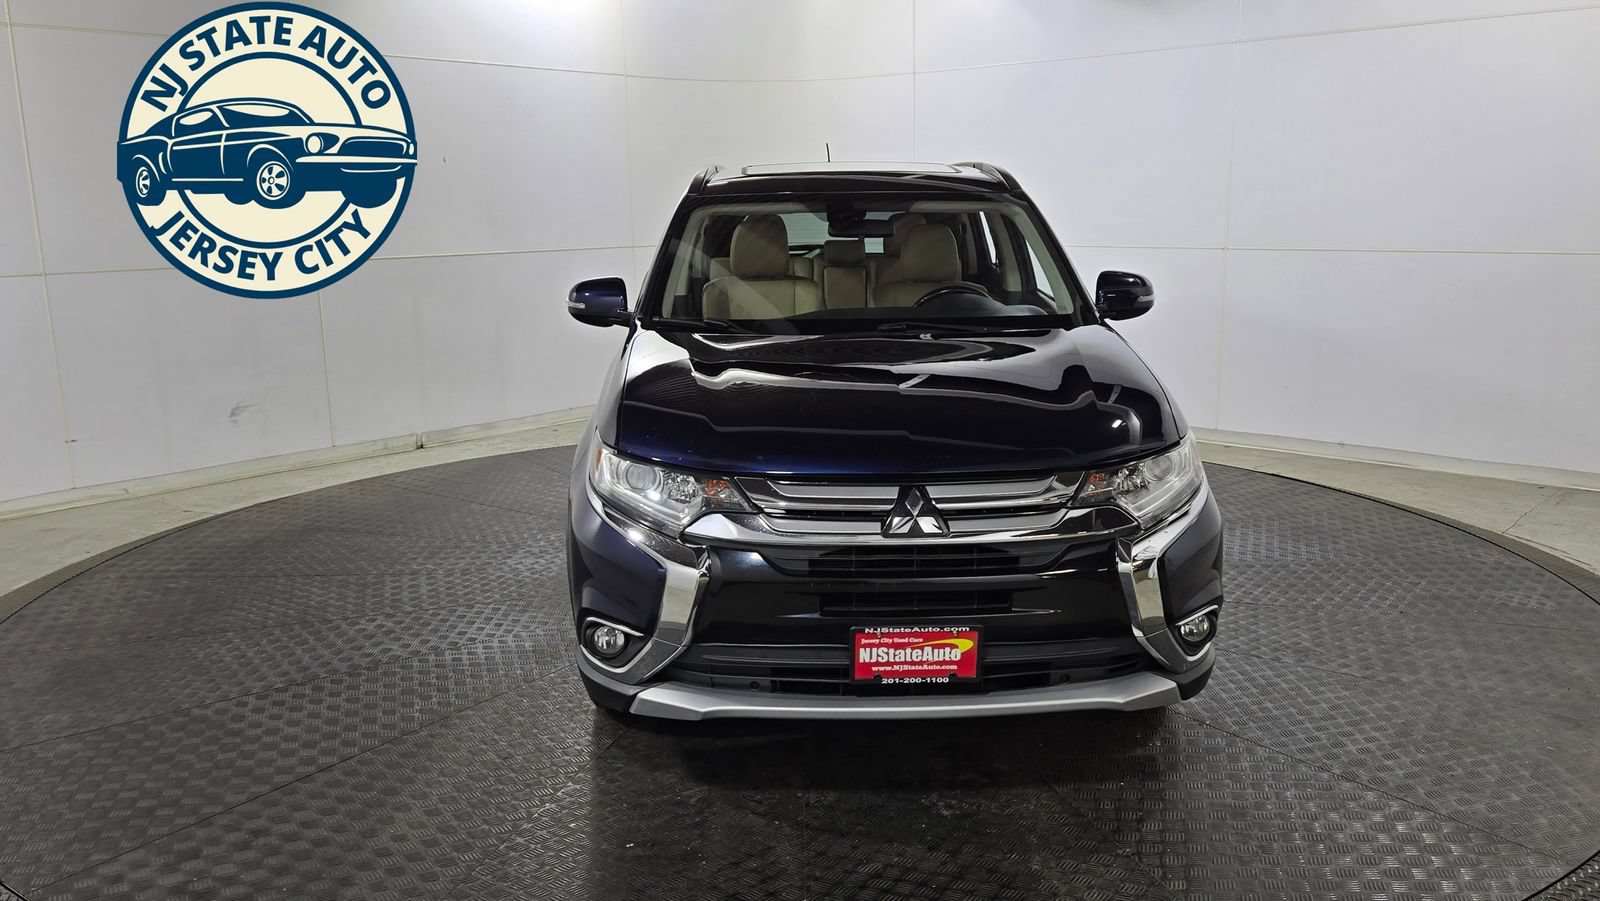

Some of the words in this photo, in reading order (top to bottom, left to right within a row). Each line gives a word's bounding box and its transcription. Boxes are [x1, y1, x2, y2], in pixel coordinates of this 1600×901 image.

[864, 626, 970, 634] NJStateAuto.com
[859, 646, 961, 663] NJStateAuto
[871, 664, 958, 672] www.NJStateAuto.com
